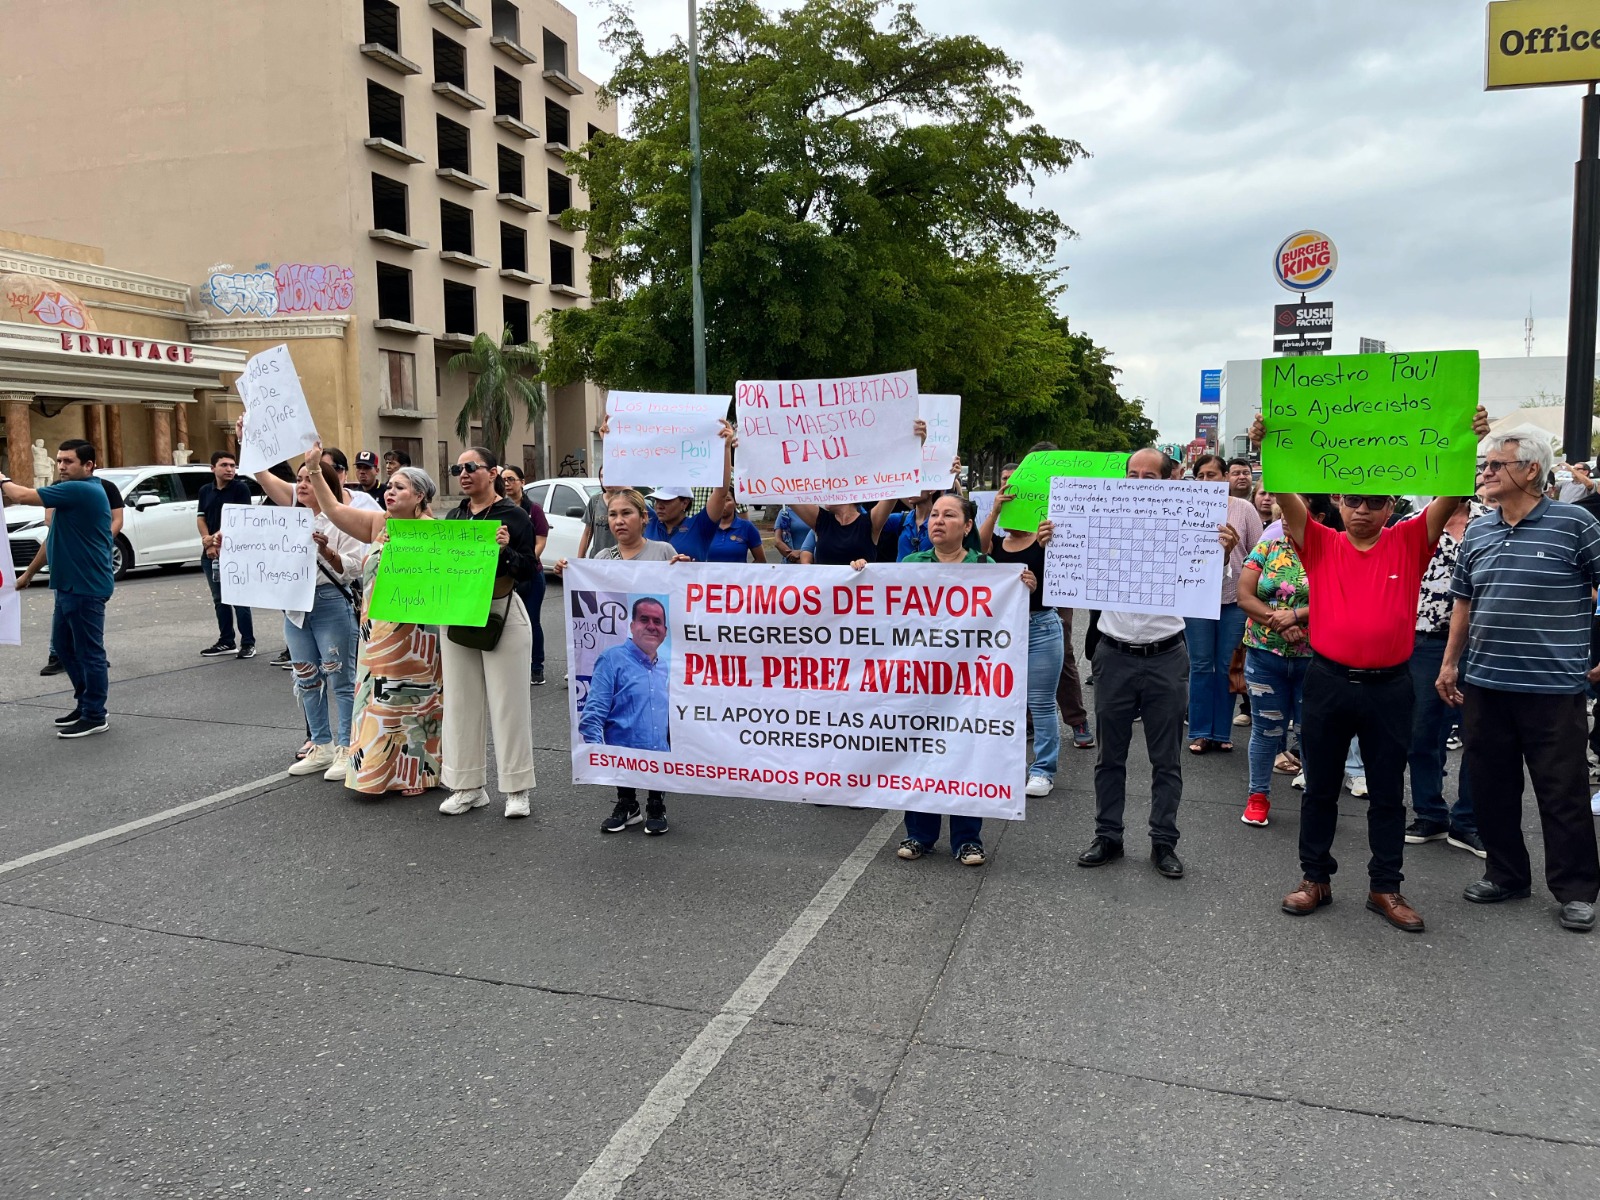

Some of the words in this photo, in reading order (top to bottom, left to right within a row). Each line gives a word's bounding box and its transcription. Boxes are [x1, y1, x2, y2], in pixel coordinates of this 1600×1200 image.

[1281, 241, 1329, 265] BURGER
[1283, 251, 1330, 279] KING
[1296, 308, 1333, 320] SUSHI
[1296, 317, 1332, 327] FACTORY
[61, 332, 194, 363] ERMITAGE
[1273, 362, 1369, 388] Maestro
[260, 386, 280, 398] De
[738, 383, 769, 409] POR
[778, 383, 806, 408] LA
[614, 396, 642, 412] Los
[648, 401, 709, 413] maestros
[266, 405, 296, 429] Profe
[744, 415, 778, 437] DEL
[786, 408, 876, 435] MAESTRO
[929, 412, 949, 427] de
[617, 420, 631, 435] te
[635, 423, 697, 437] queremos
[928, 431, 950, 443] stro
[1269, 428, 1294, 449] Te
[1310, 430, 1409, 449] Queremos
[1420, 428, 1449, 448] De
[611, 446, 627, 459] de
[631, 446, 677, 459] regreso
[781, 434, 860, 465] PAÚL
[922, 445, 939, 461] EZ
[1027, 452, 1093, 469] Maestro
[1317, 453, 1417, 486] Regreso
[771, 475, 849, 494] QUEREMOS
[855, 474, 869, 486] DE
[875, 468, 920, 484] VUELTA!
[1015, 467, 1038, 483] Tus
[1008, 485, 1049, 502] Quere
[1052, 477, 1097, 490] Solicitamos
[1103, 480, 1111, 491] la
[1169, 485, 1209, 495] inmediata
[1213, 485, 1226, 496] de
[1052, 490, 1061, 500] las
[1064, 493, 1108, 503] autoridades
[1112, 496, 1130, 505] para
[1133, 496, 1145, 505] que
[1147, 497, 1173, 507] apoyen
[1197, 500, 1227, 510] regreso
[225, 508, 237, 527] Tu
[296, 512, 308, 528] te
[1051, 504, 1065, 512] CON
[1070, 504, 1085, 512] VIDA
[1092, 504, 1100, 513] de
[1103, 504, 1131, 514] nuestro
[1134, 507, 1158, 517] amigo
[388, 521, 428, 540] Maestro
[225, 536, 266, 553] Queremos
[269, 543, 280, 551] en
[282, 534, 308, 554] Casa
[386, 544, 424, 561] queremos
[428, 541, 441, 555] de
[481, 545, 496, 557] tus
[384, 562, 423, 575] alumnos
[426, 561, 440, 574] te
[1177, 574, 1205, 588] Apoyo
[390, 587, 426, 613] Ayuda
[685, 583, 822, 615] PEDIMOS
[833, 585, 875, 615] DE
[885, 585, 993, 618] FAVOR
[684, 624, 711, 642] EL
[718, 625, 832, 645] REGRESO
[840, 627, 884, 646] DEL
[892, 628, 1011, 649] MAESTRO
[683, 653, 752, 687] PAUL
[762, 656, 850, 691] PEREZ
[859, 654, 1013, 698] AVENDAÑO
[676, 705, 689, 721] Y
[694, 705, 717, 722] EL
[722, 707, 790, 725] APOYO
[796, 709, 821, 726] DE
[827, 711, 864, 728] LAS
[869, 713, 1015, 736] AUTORIDADES
[740, 729, 946, 754] CORRESPONDIENTES
[589, 753, 659, 773] ESTAMOS
[663, 762, 799, 785] DESESPERADOS
[804, 771, 841, 787] POR
[847, 773, 871, 788] SU
[877, 774, 1011, 799] DESAPARICION
